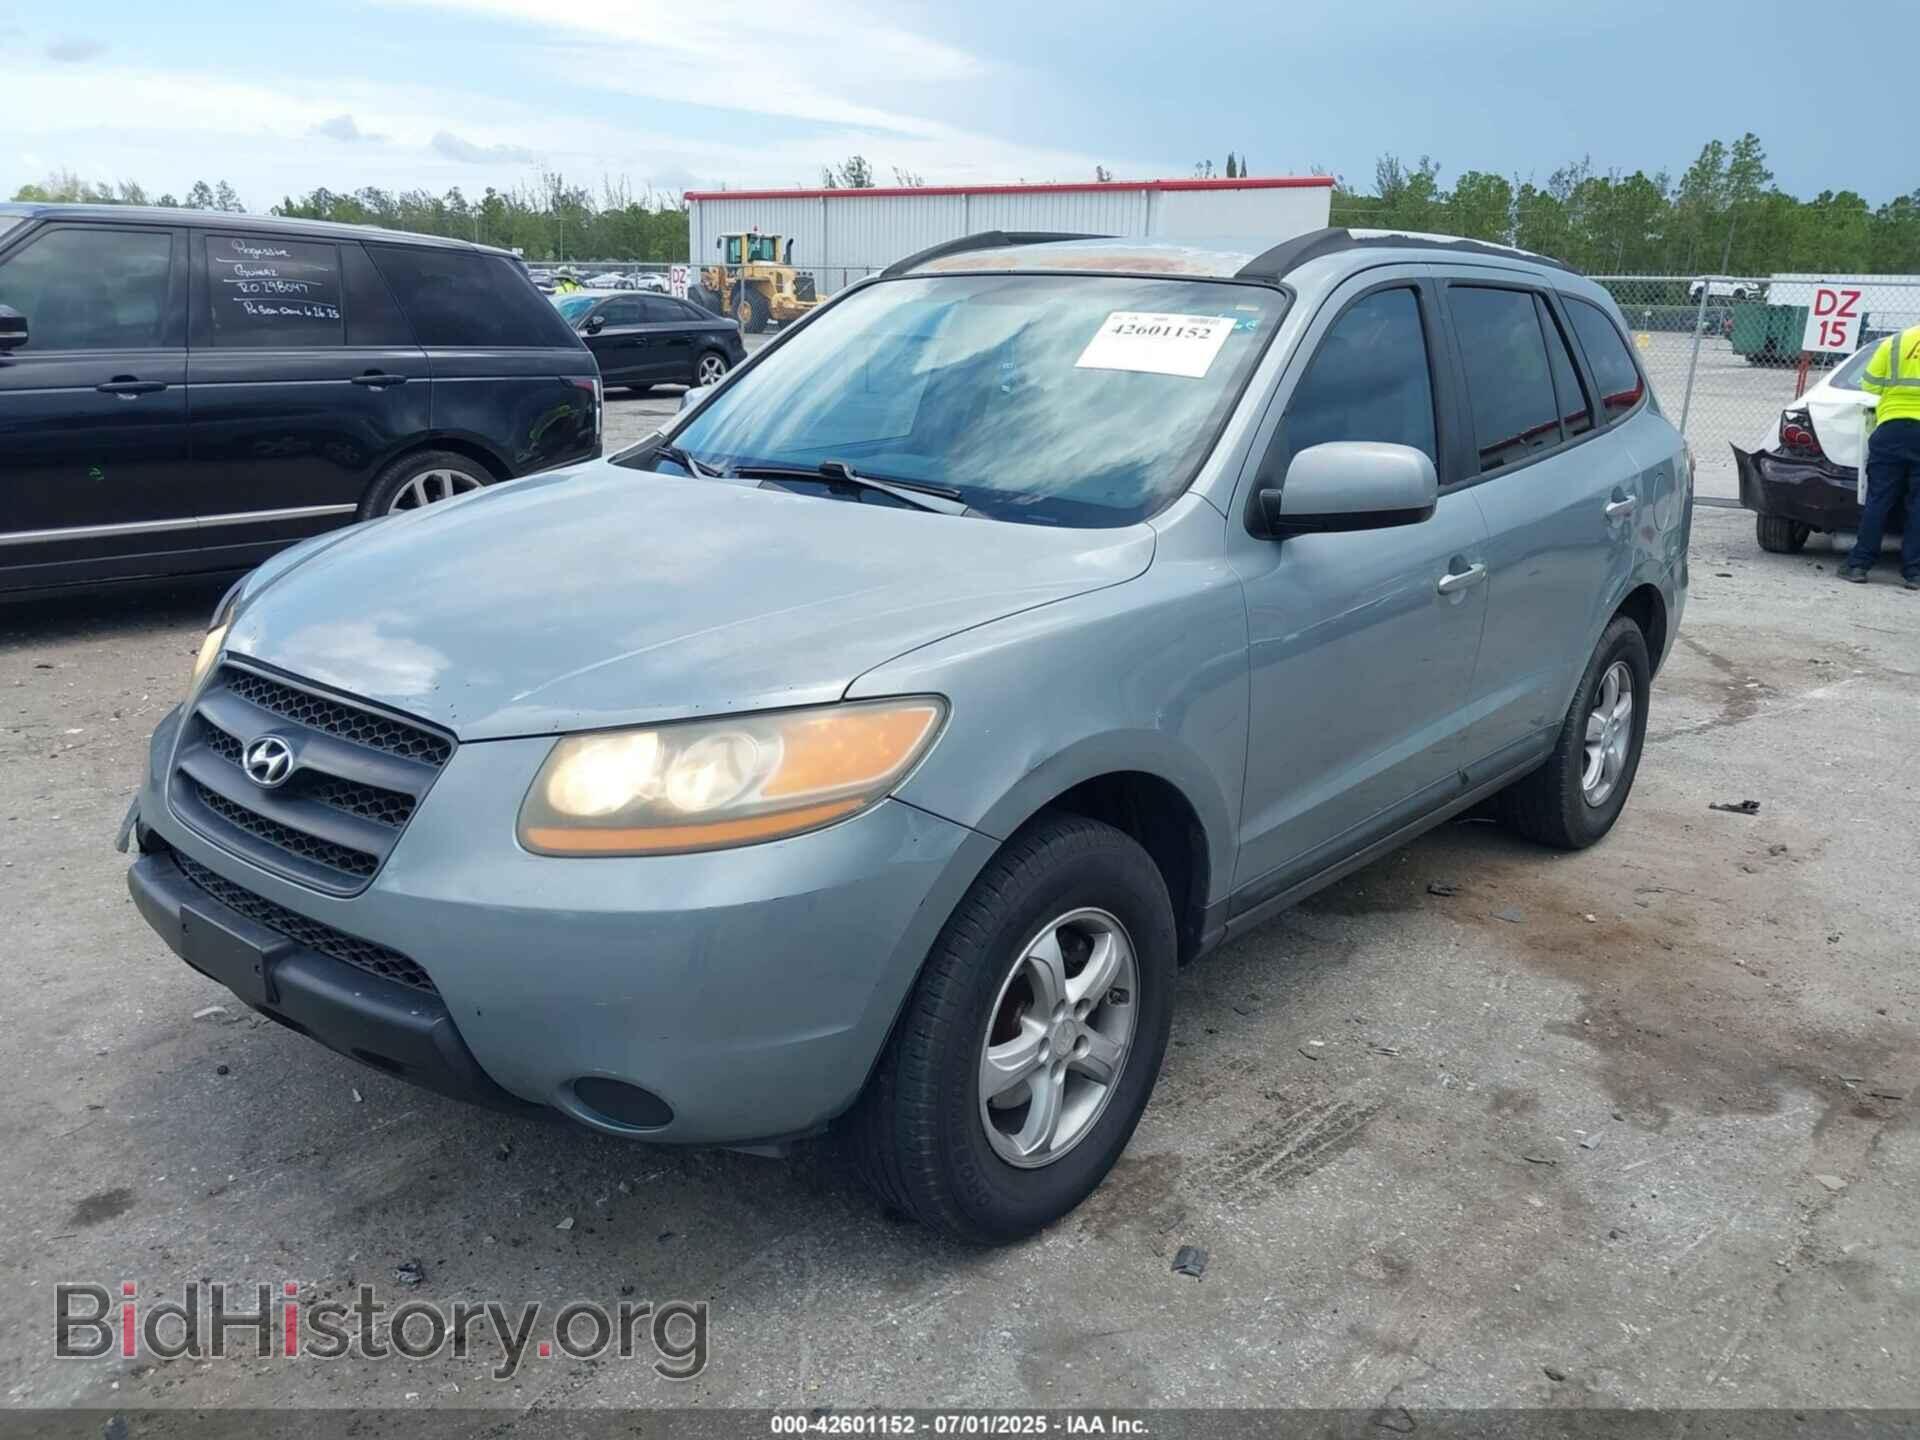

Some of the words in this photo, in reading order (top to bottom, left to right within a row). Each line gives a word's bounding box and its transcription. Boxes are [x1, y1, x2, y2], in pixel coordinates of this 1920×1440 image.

[672, 268, 686, 284] DZ
[1814, 289, 1861, 318] DZ
[1111, 323, 1212, 340] 42601152
[1819, 321, 1847, 347] 15
